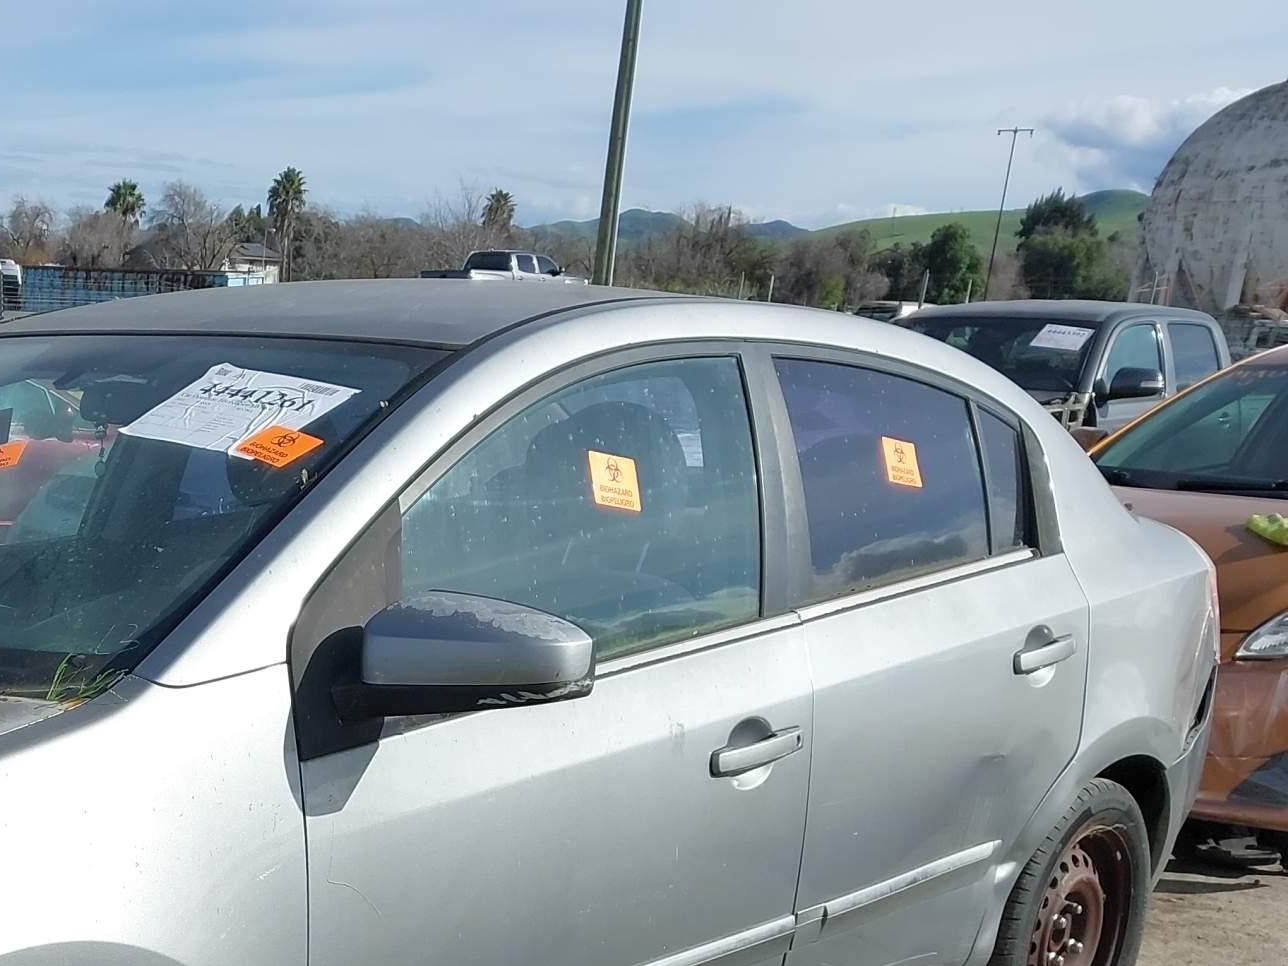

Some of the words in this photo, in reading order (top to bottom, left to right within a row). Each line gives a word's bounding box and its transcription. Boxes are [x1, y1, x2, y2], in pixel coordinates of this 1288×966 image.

[200, 383, 315, 412] 44441261
[249, 441, 289, 459] BIOHAZARD
[599, 484, 633, 498] BIOHAZARD
